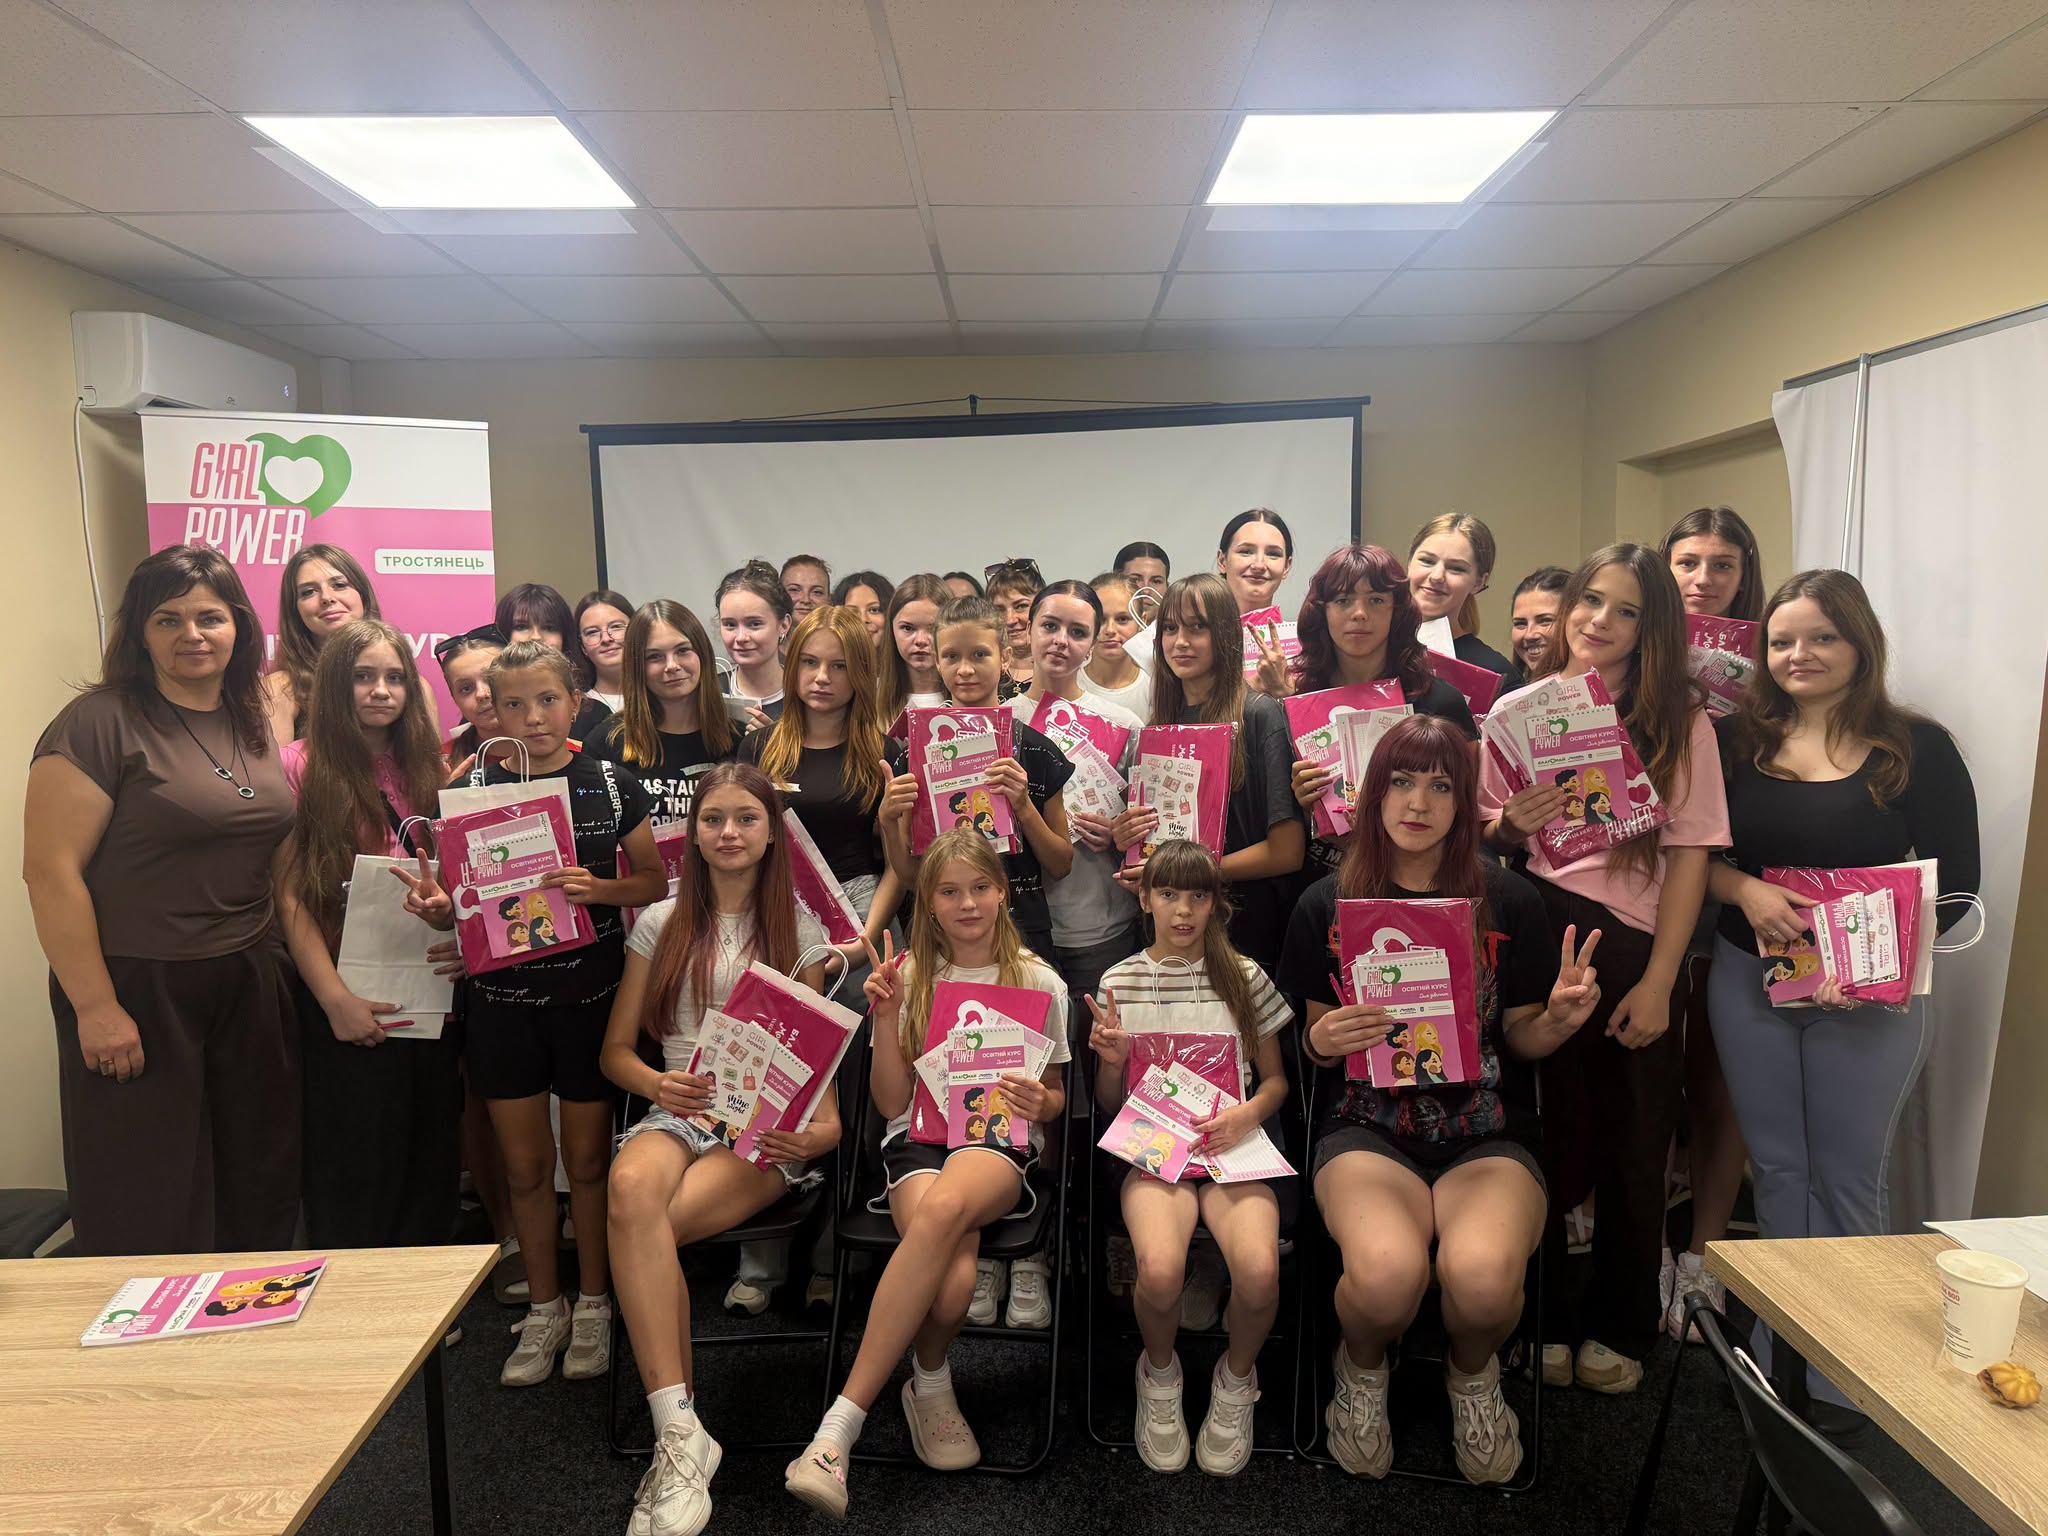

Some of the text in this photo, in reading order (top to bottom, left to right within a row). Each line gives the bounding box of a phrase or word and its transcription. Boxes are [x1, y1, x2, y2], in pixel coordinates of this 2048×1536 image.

[190, 442, 260, 500] GIRL
[183, 506, 306, 565] POWER
[382, 556, 485, 570] ТРОСТЯНЕЦЬ
[1556, 684, 1580, 696] GIRL
[1557, 692, 1581, 702] POWER
[1535, 735, 1560, 751] POWER
[638, 778, 700, 796] AS TAU
[603, 772, 623, 831] LAGERFE
[664, 797, 692, 814] THI
[477, 862, 502, 879] POWER
[1367, 984, 1392, 999] POWER
[1431, 983, 1448, 991] КУРС
[746, 1038, 766, 1053] POWER
[749, 1031, 768, 1047] GIRL
[952, 1050, 974, 1064] POWER
[768, 1067, 783, 1081] ВІТНІЙ
